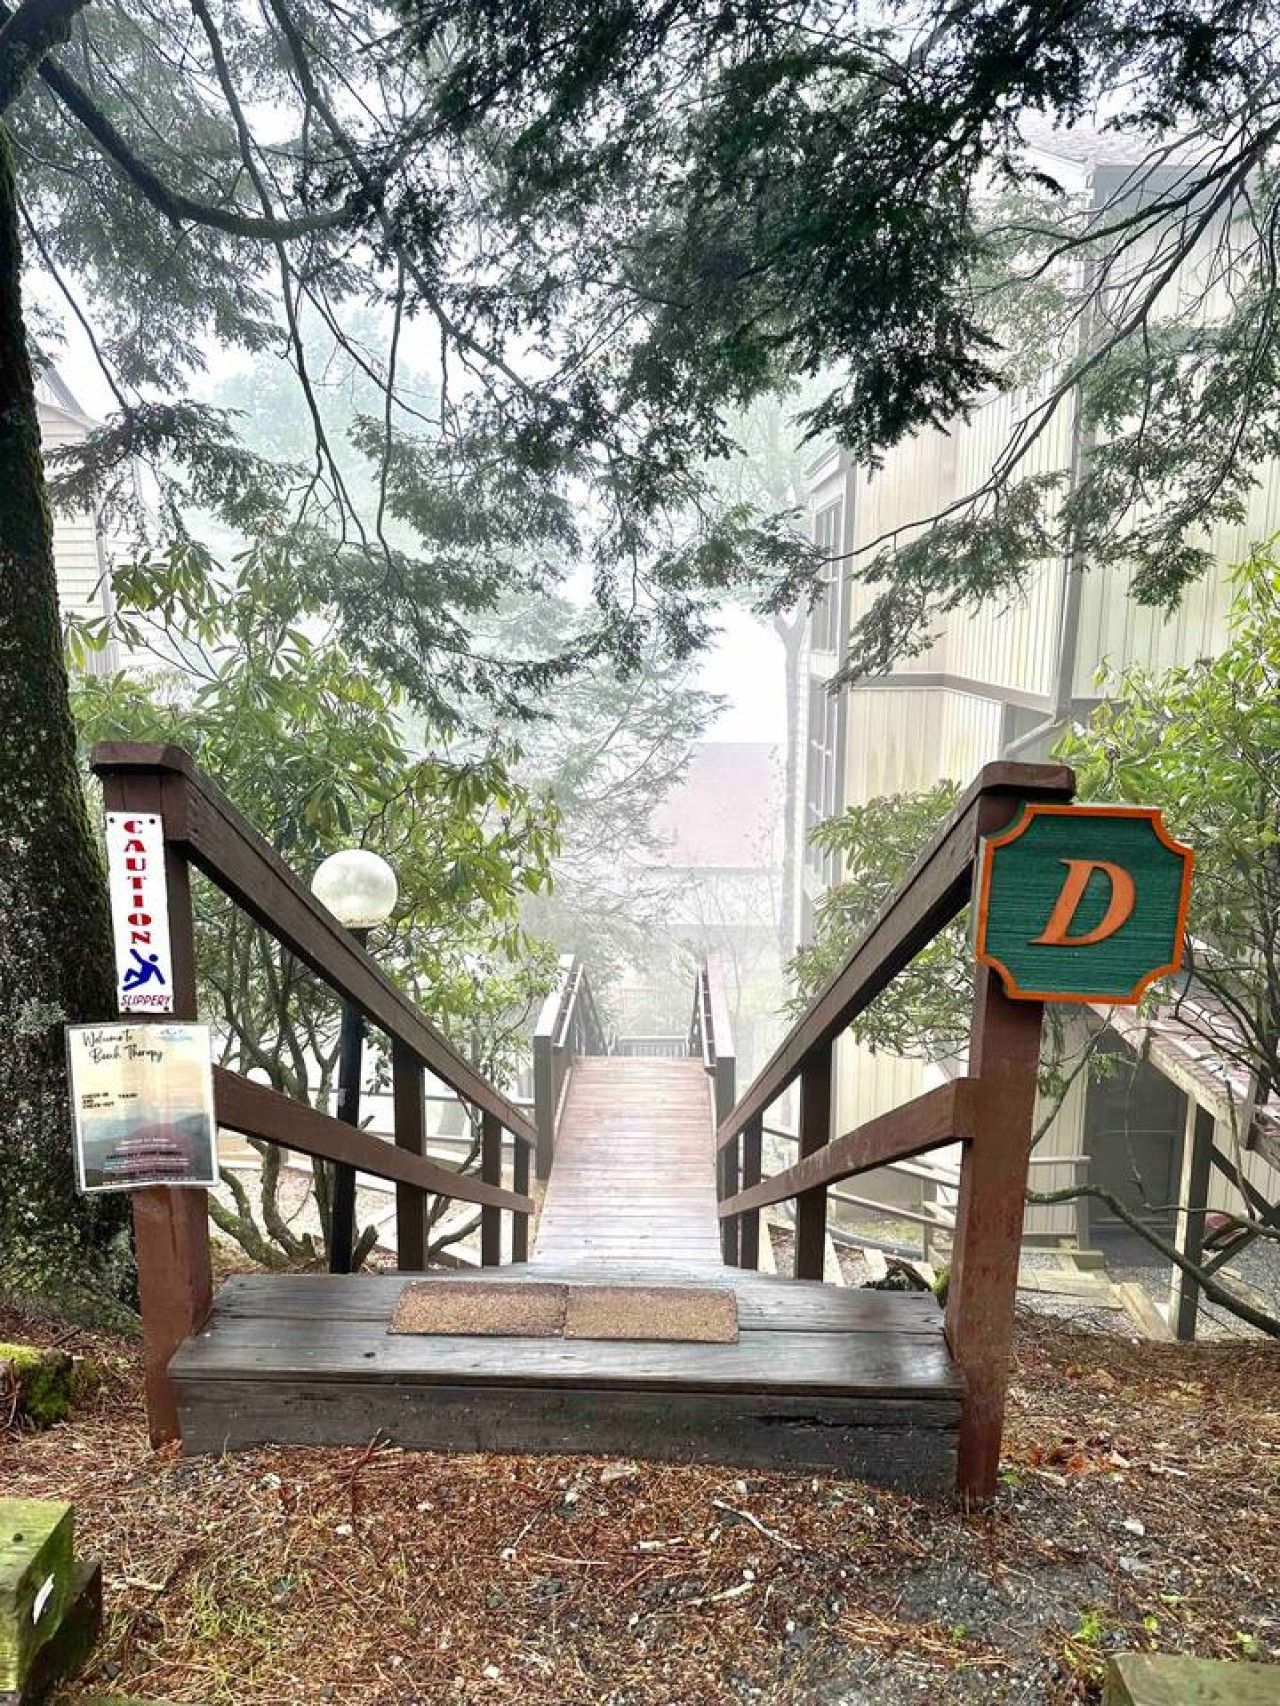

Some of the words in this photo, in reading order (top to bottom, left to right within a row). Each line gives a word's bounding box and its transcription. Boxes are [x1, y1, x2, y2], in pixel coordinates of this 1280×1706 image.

[123, 820, 152, 944] CAUTION
[1027, 858, 1136, 947] D
[120, 994, 172, 1007] SLIPPERY
[82, 1030, 122, 1047] Welcome
[123, 1043, 162, 1062] Therapy
